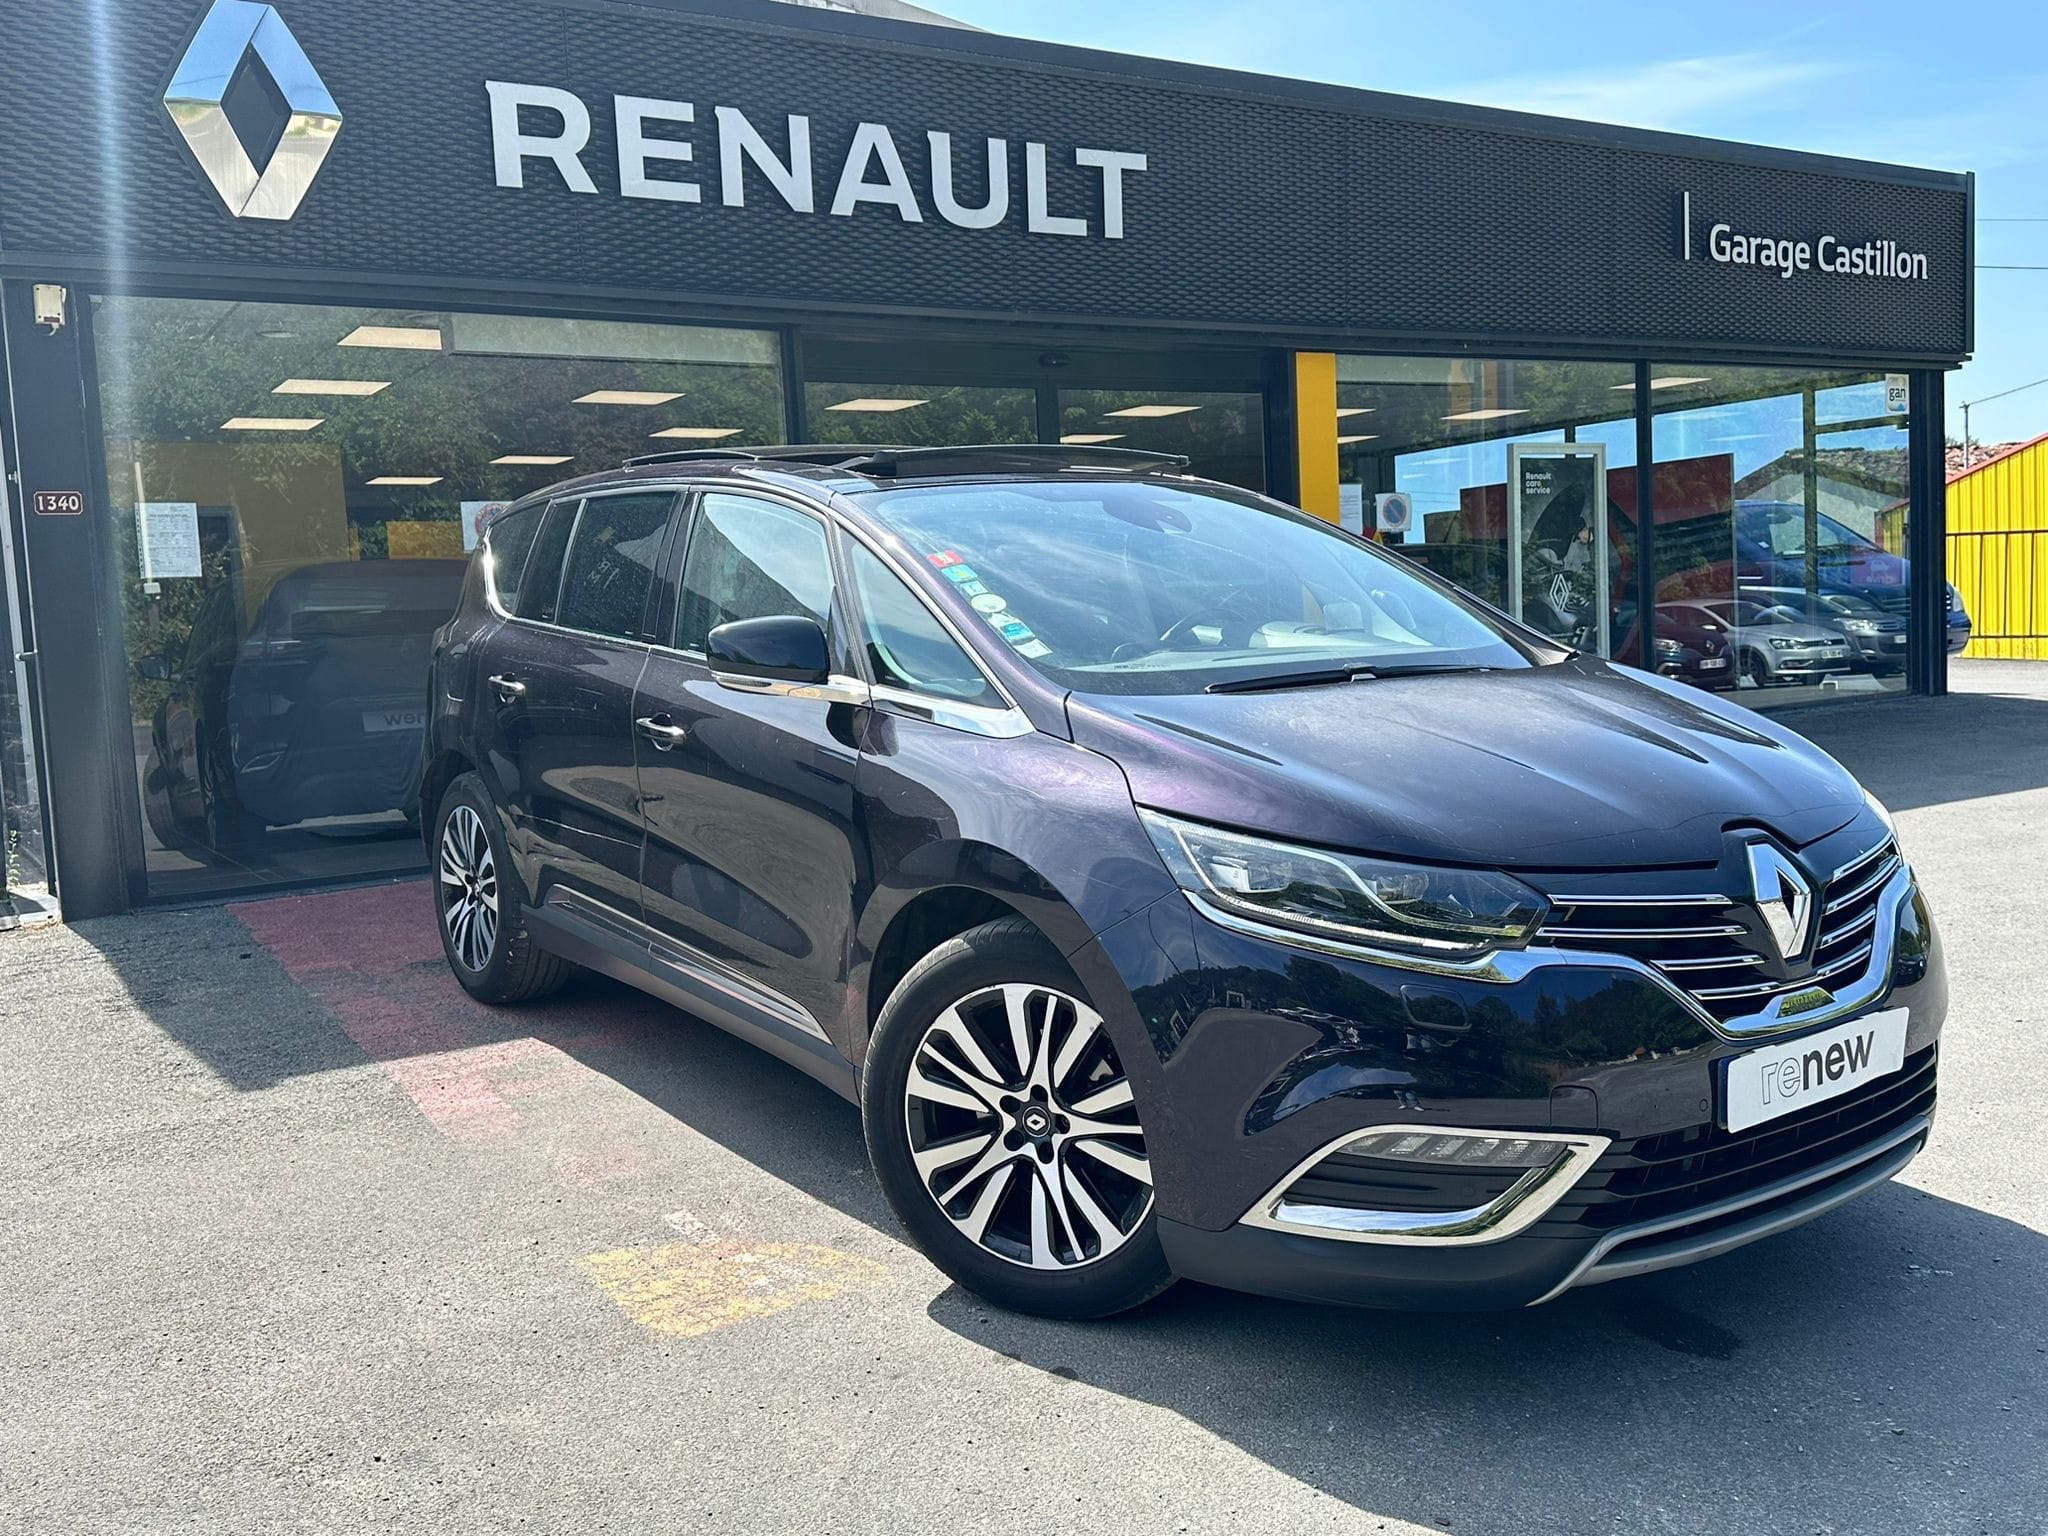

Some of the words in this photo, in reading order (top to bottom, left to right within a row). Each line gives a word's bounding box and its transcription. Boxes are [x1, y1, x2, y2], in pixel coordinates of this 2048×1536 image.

[485, 80, 1148, 239] RENAULT
[1710, 223, 1810, 278] Garage
[1817, 235, 1928, 280] Castillon
[1889, 388, 1906, 401] gan
[1525, 472, 1552, 480] Renault
[37, 495, 79, 511] 1340
[1761, 1030, 1875, 1105] renew
